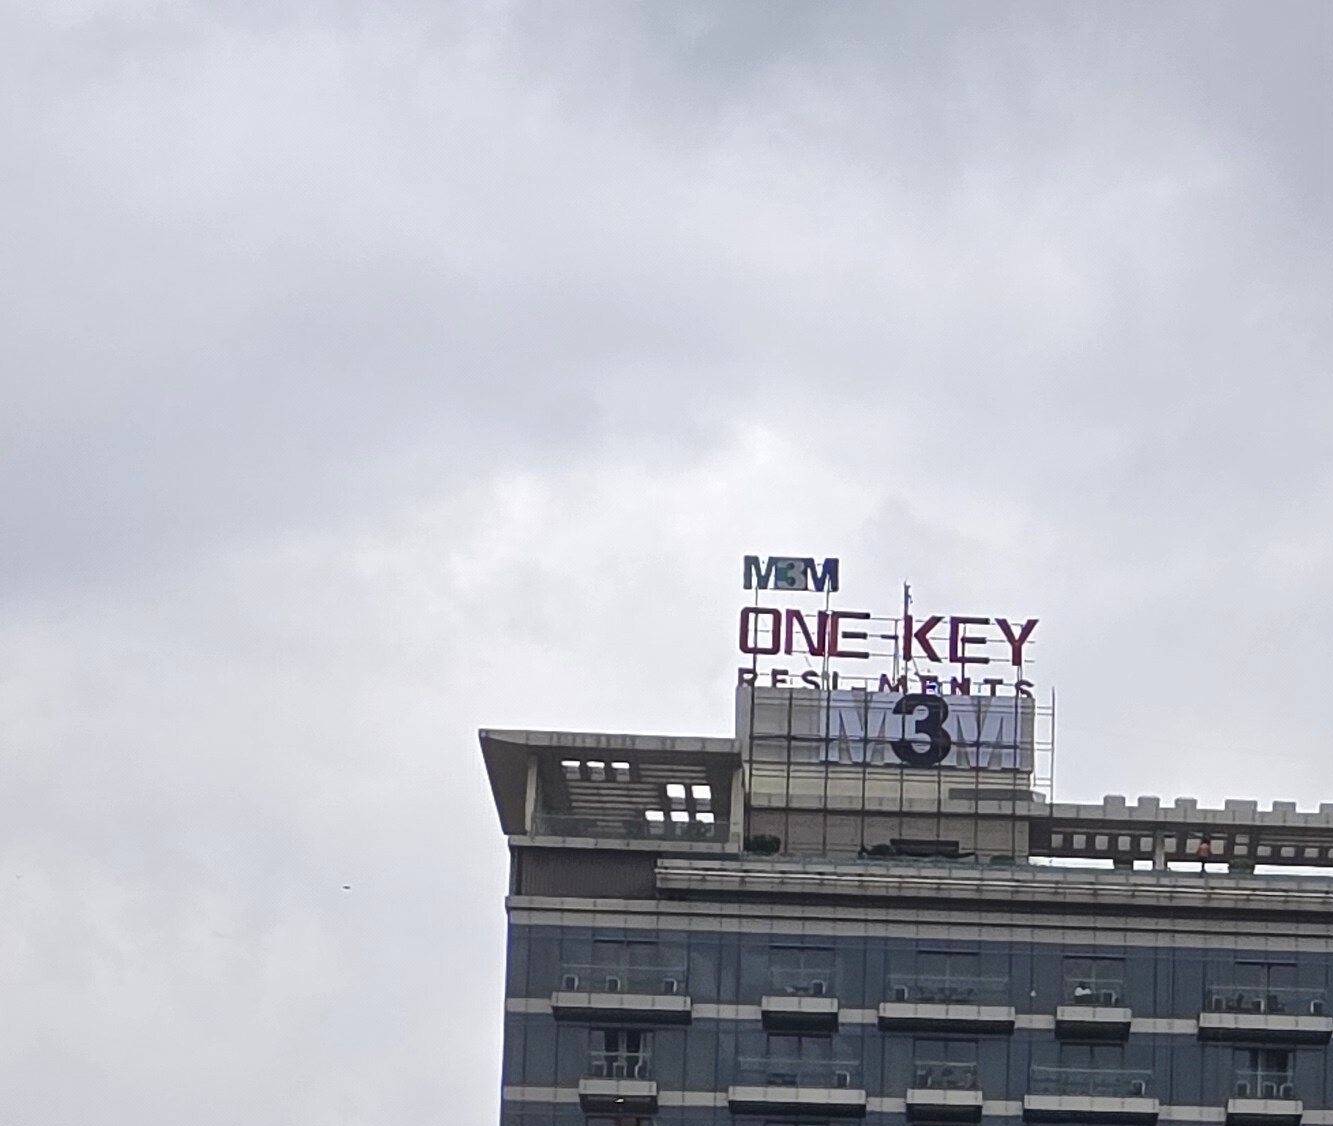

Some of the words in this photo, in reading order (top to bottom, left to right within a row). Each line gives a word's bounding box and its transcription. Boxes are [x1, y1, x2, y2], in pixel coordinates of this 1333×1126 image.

[743, 554, 840, 593] M3M
[739, 606, 871, 659] ONE
[902, 614, 1039, 666] KEY
